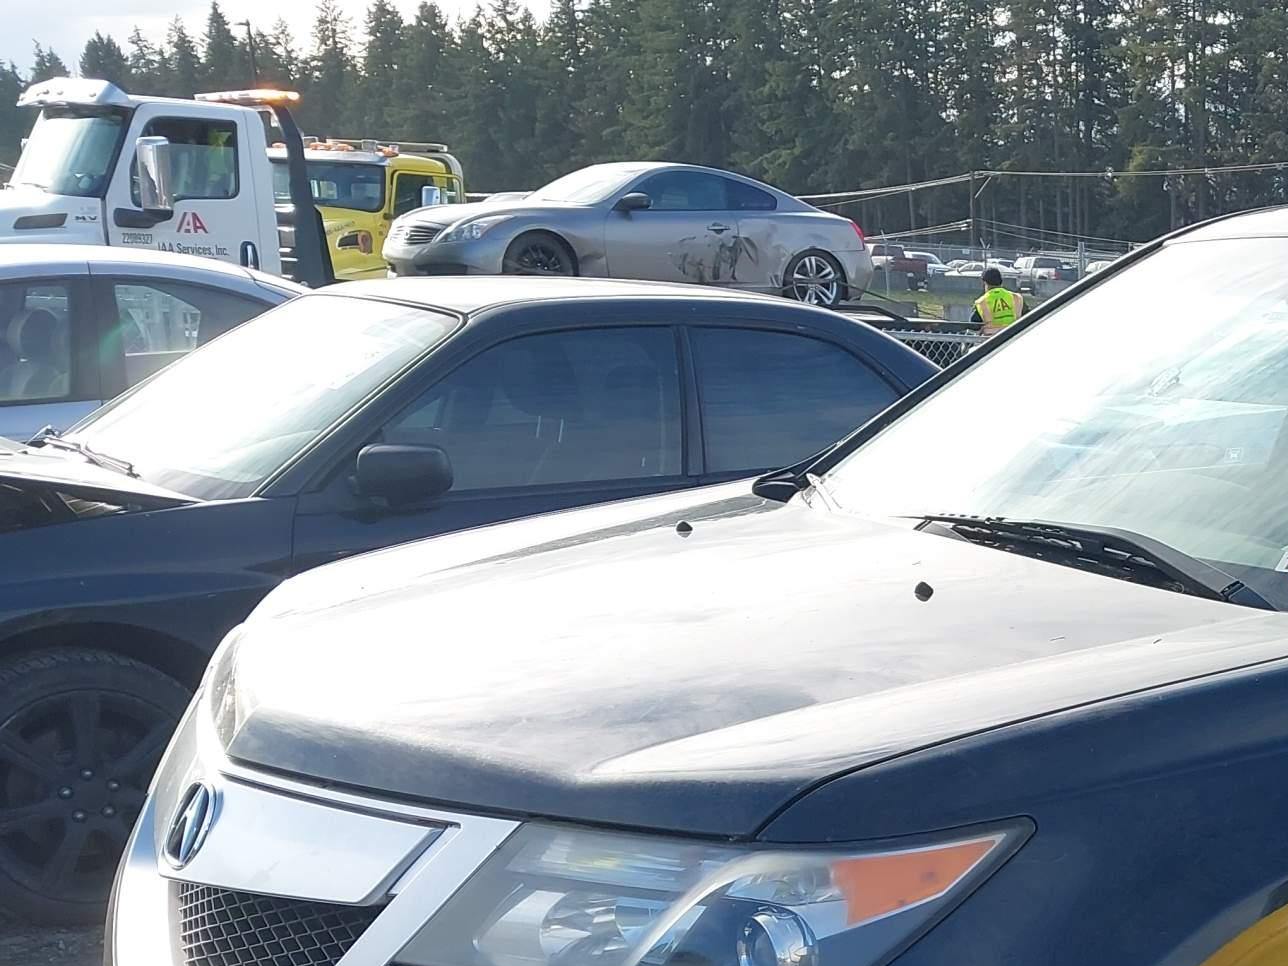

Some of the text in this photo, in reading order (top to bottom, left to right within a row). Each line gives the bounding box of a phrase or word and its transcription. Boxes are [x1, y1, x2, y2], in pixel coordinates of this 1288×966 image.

[176, 211, 208, 234] IAA
[176, 243, 215, 256] Services,
[215, 244, 229, 257] Inc.
[993, 298, 1010, 313] IAA
